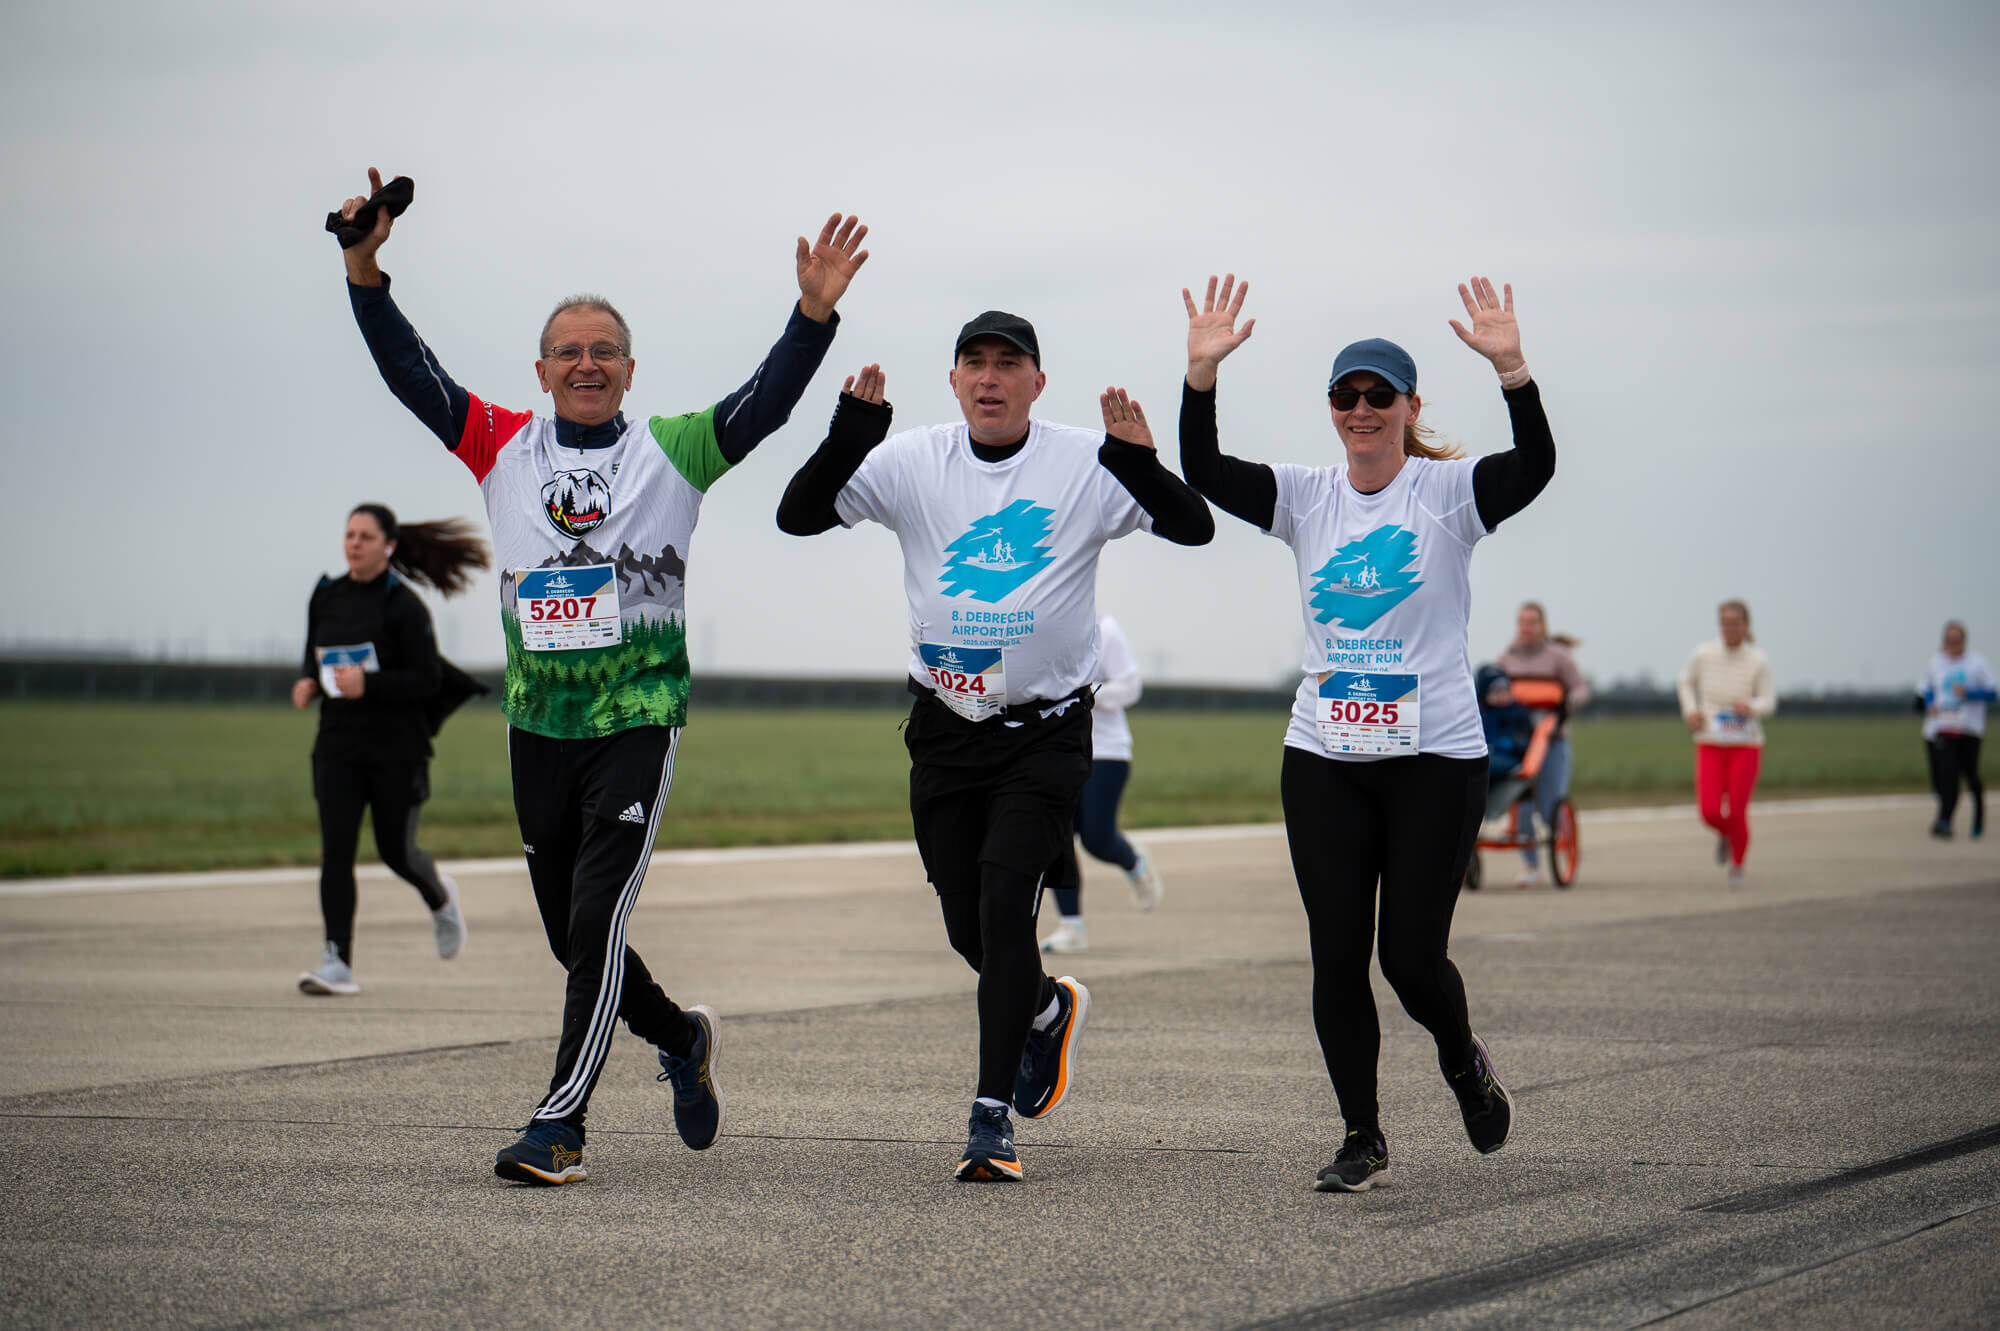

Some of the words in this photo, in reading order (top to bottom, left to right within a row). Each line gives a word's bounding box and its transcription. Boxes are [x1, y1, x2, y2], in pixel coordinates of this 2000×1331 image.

[530, 597, 597, 621] 5207
[951, 610, 963, 622] 8.
[966, 609, 1035, 624] DEBRECEN
[951, 625, 1004, 638] AIRPORT
[1005, 624, 1035, 637] RUN
[1337, 638, 1403, 650] DEBRECEN
[1326, 652, 1373, 664] AIRPORT
[1375, 653, 1403, 664] RUN
[928, 667, 986, 695] 5024
[1330, 700, 1399, 725] 5025
[618, 814, 645, 824] adidas
